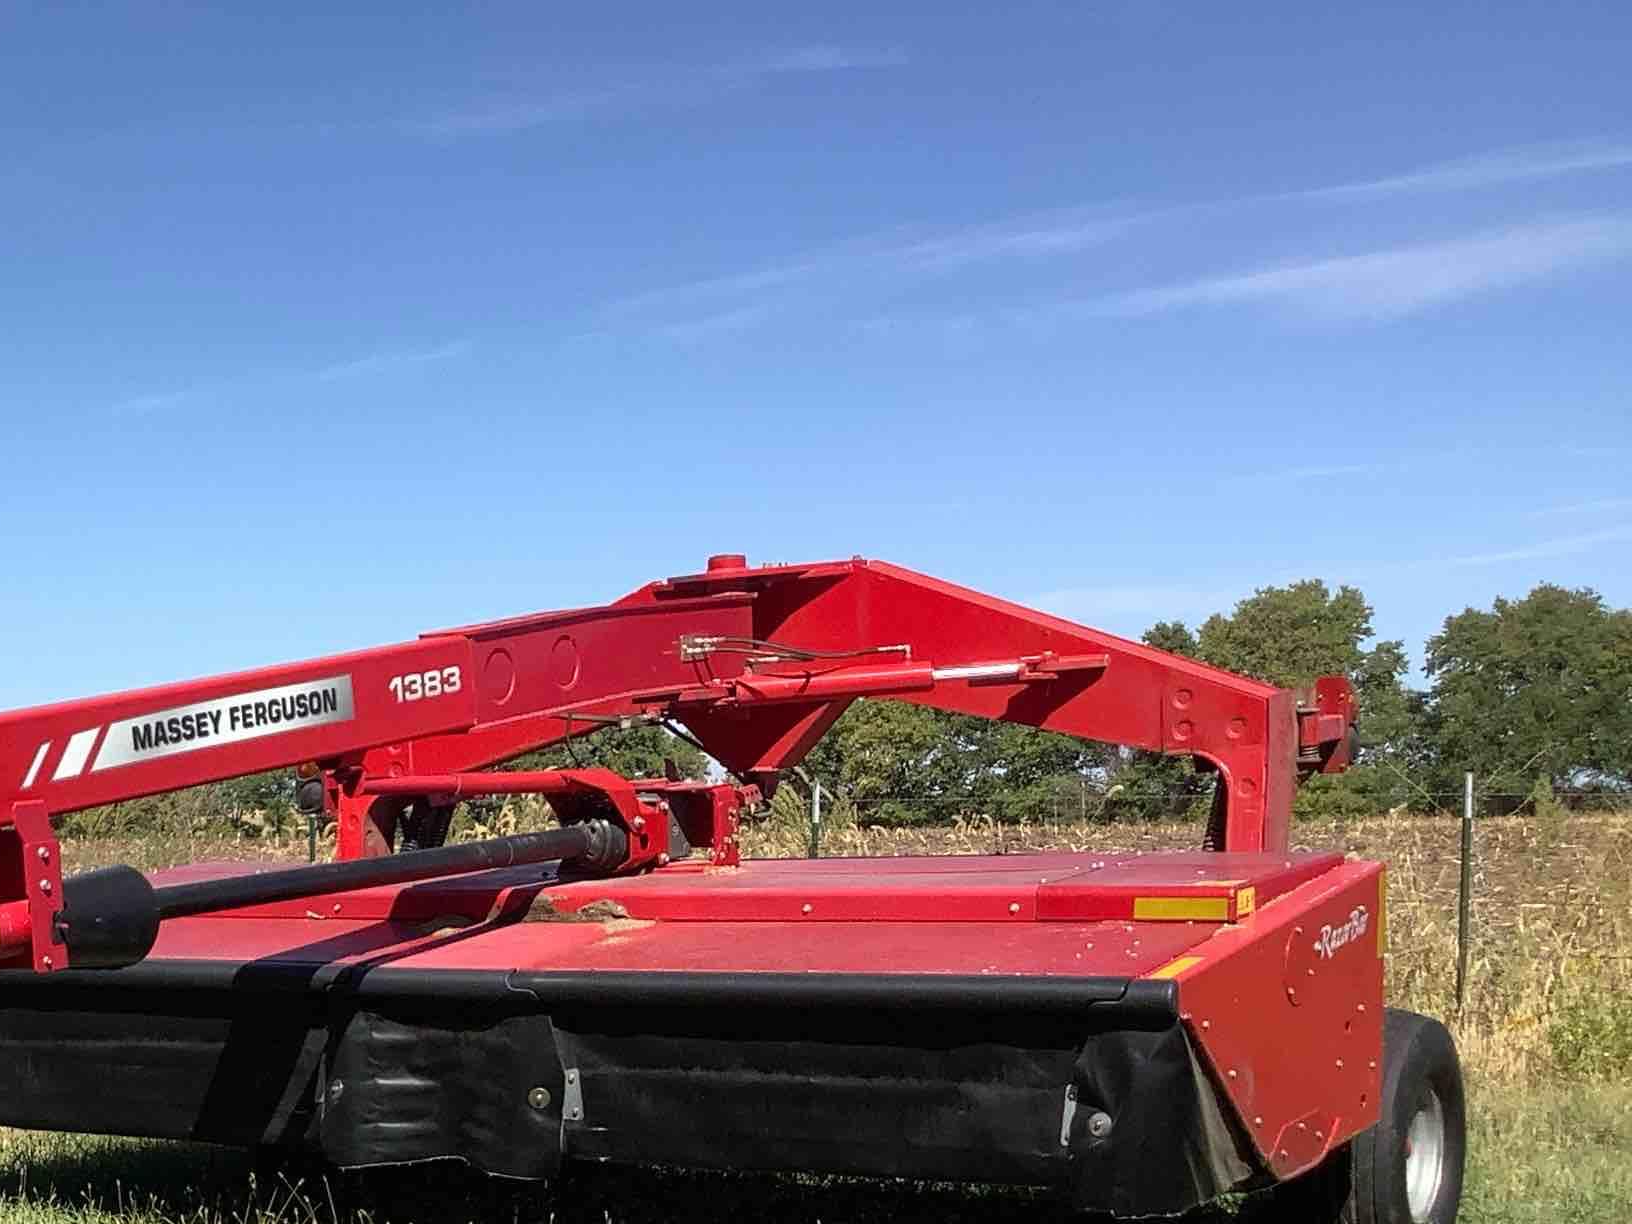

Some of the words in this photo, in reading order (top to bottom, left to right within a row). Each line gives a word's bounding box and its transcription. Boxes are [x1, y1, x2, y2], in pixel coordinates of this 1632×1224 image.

[388, 665, 462, 704] 1383
[130, 709, 223, 752] MASSEY
[229, 687, 340, 732] FERGUSON
